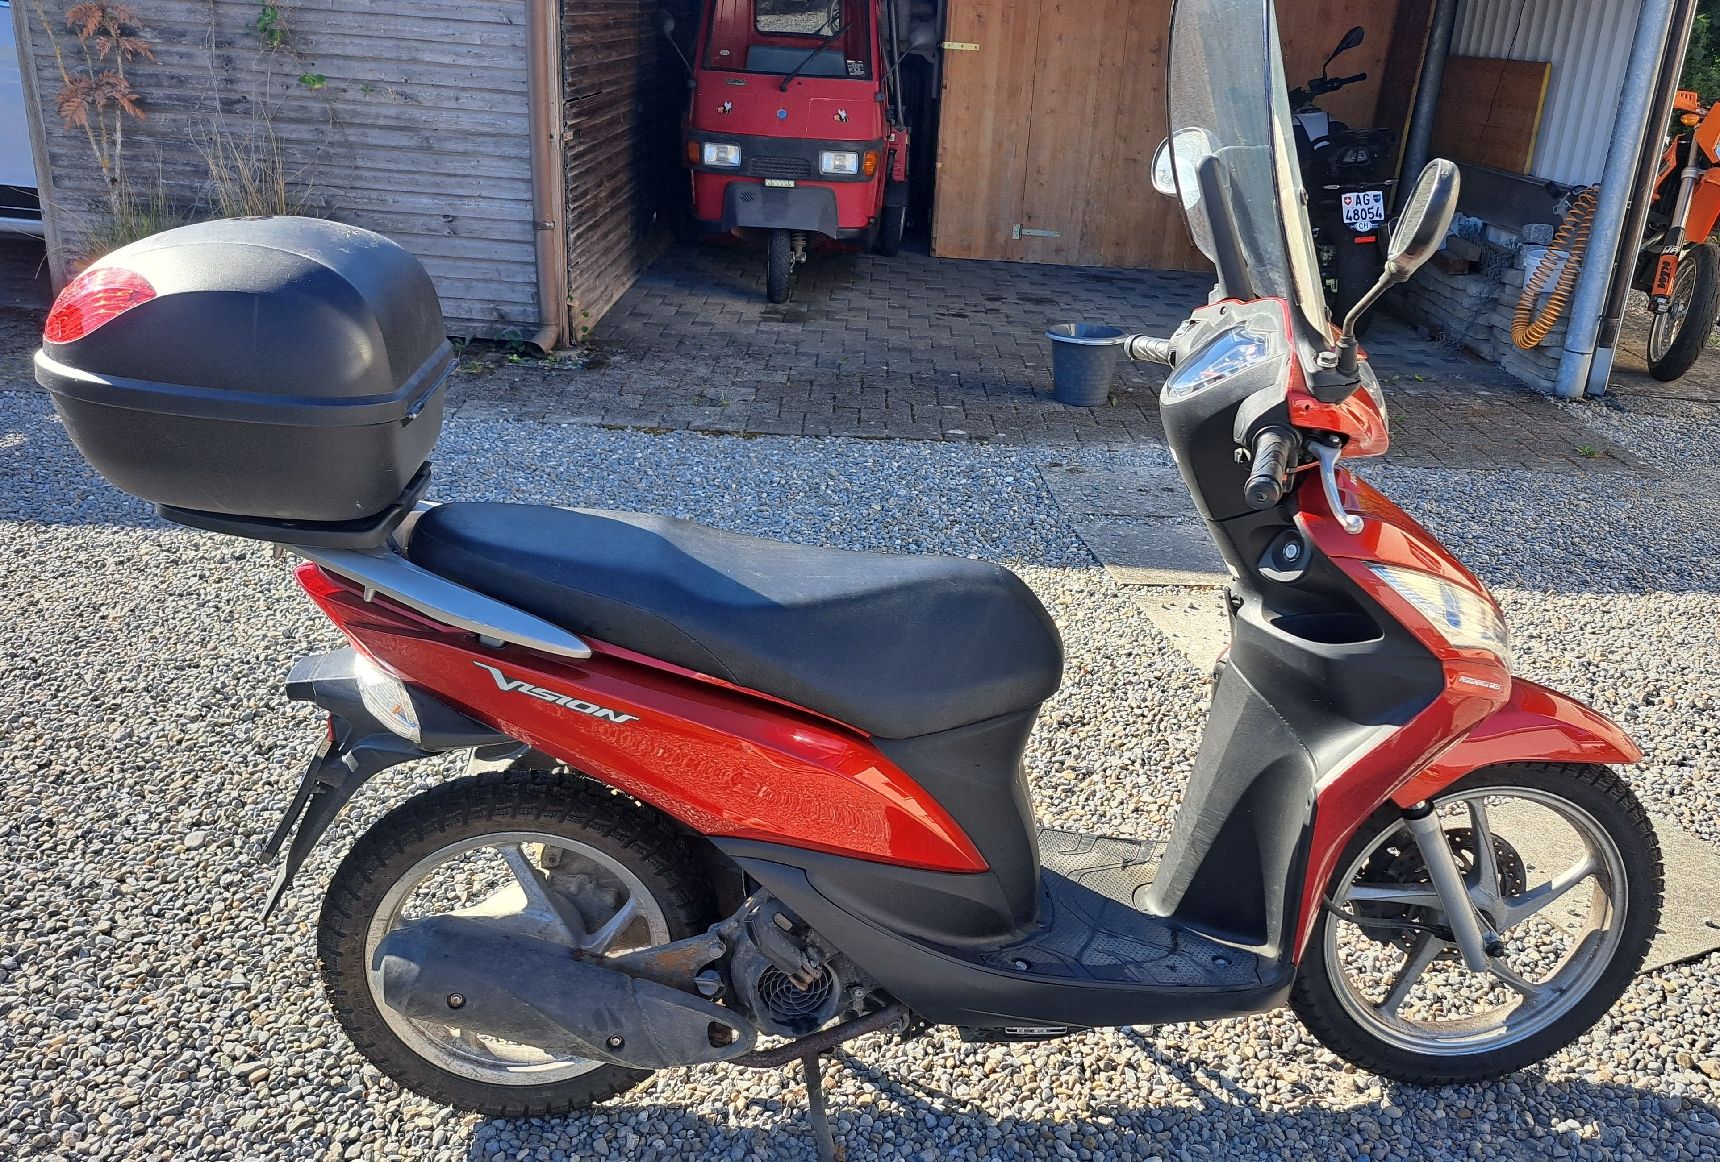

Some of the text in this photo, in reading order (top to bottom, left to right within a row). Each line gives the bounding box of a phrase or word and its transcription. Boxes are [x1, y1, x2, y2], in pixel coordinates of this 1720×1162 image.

[1356, 194, 1370, 206] AG
[1345, 206, 1383, 221] 48054
[1358, 222, 1369, 230] CH
[1657, 261, 1671, 289] KTM
